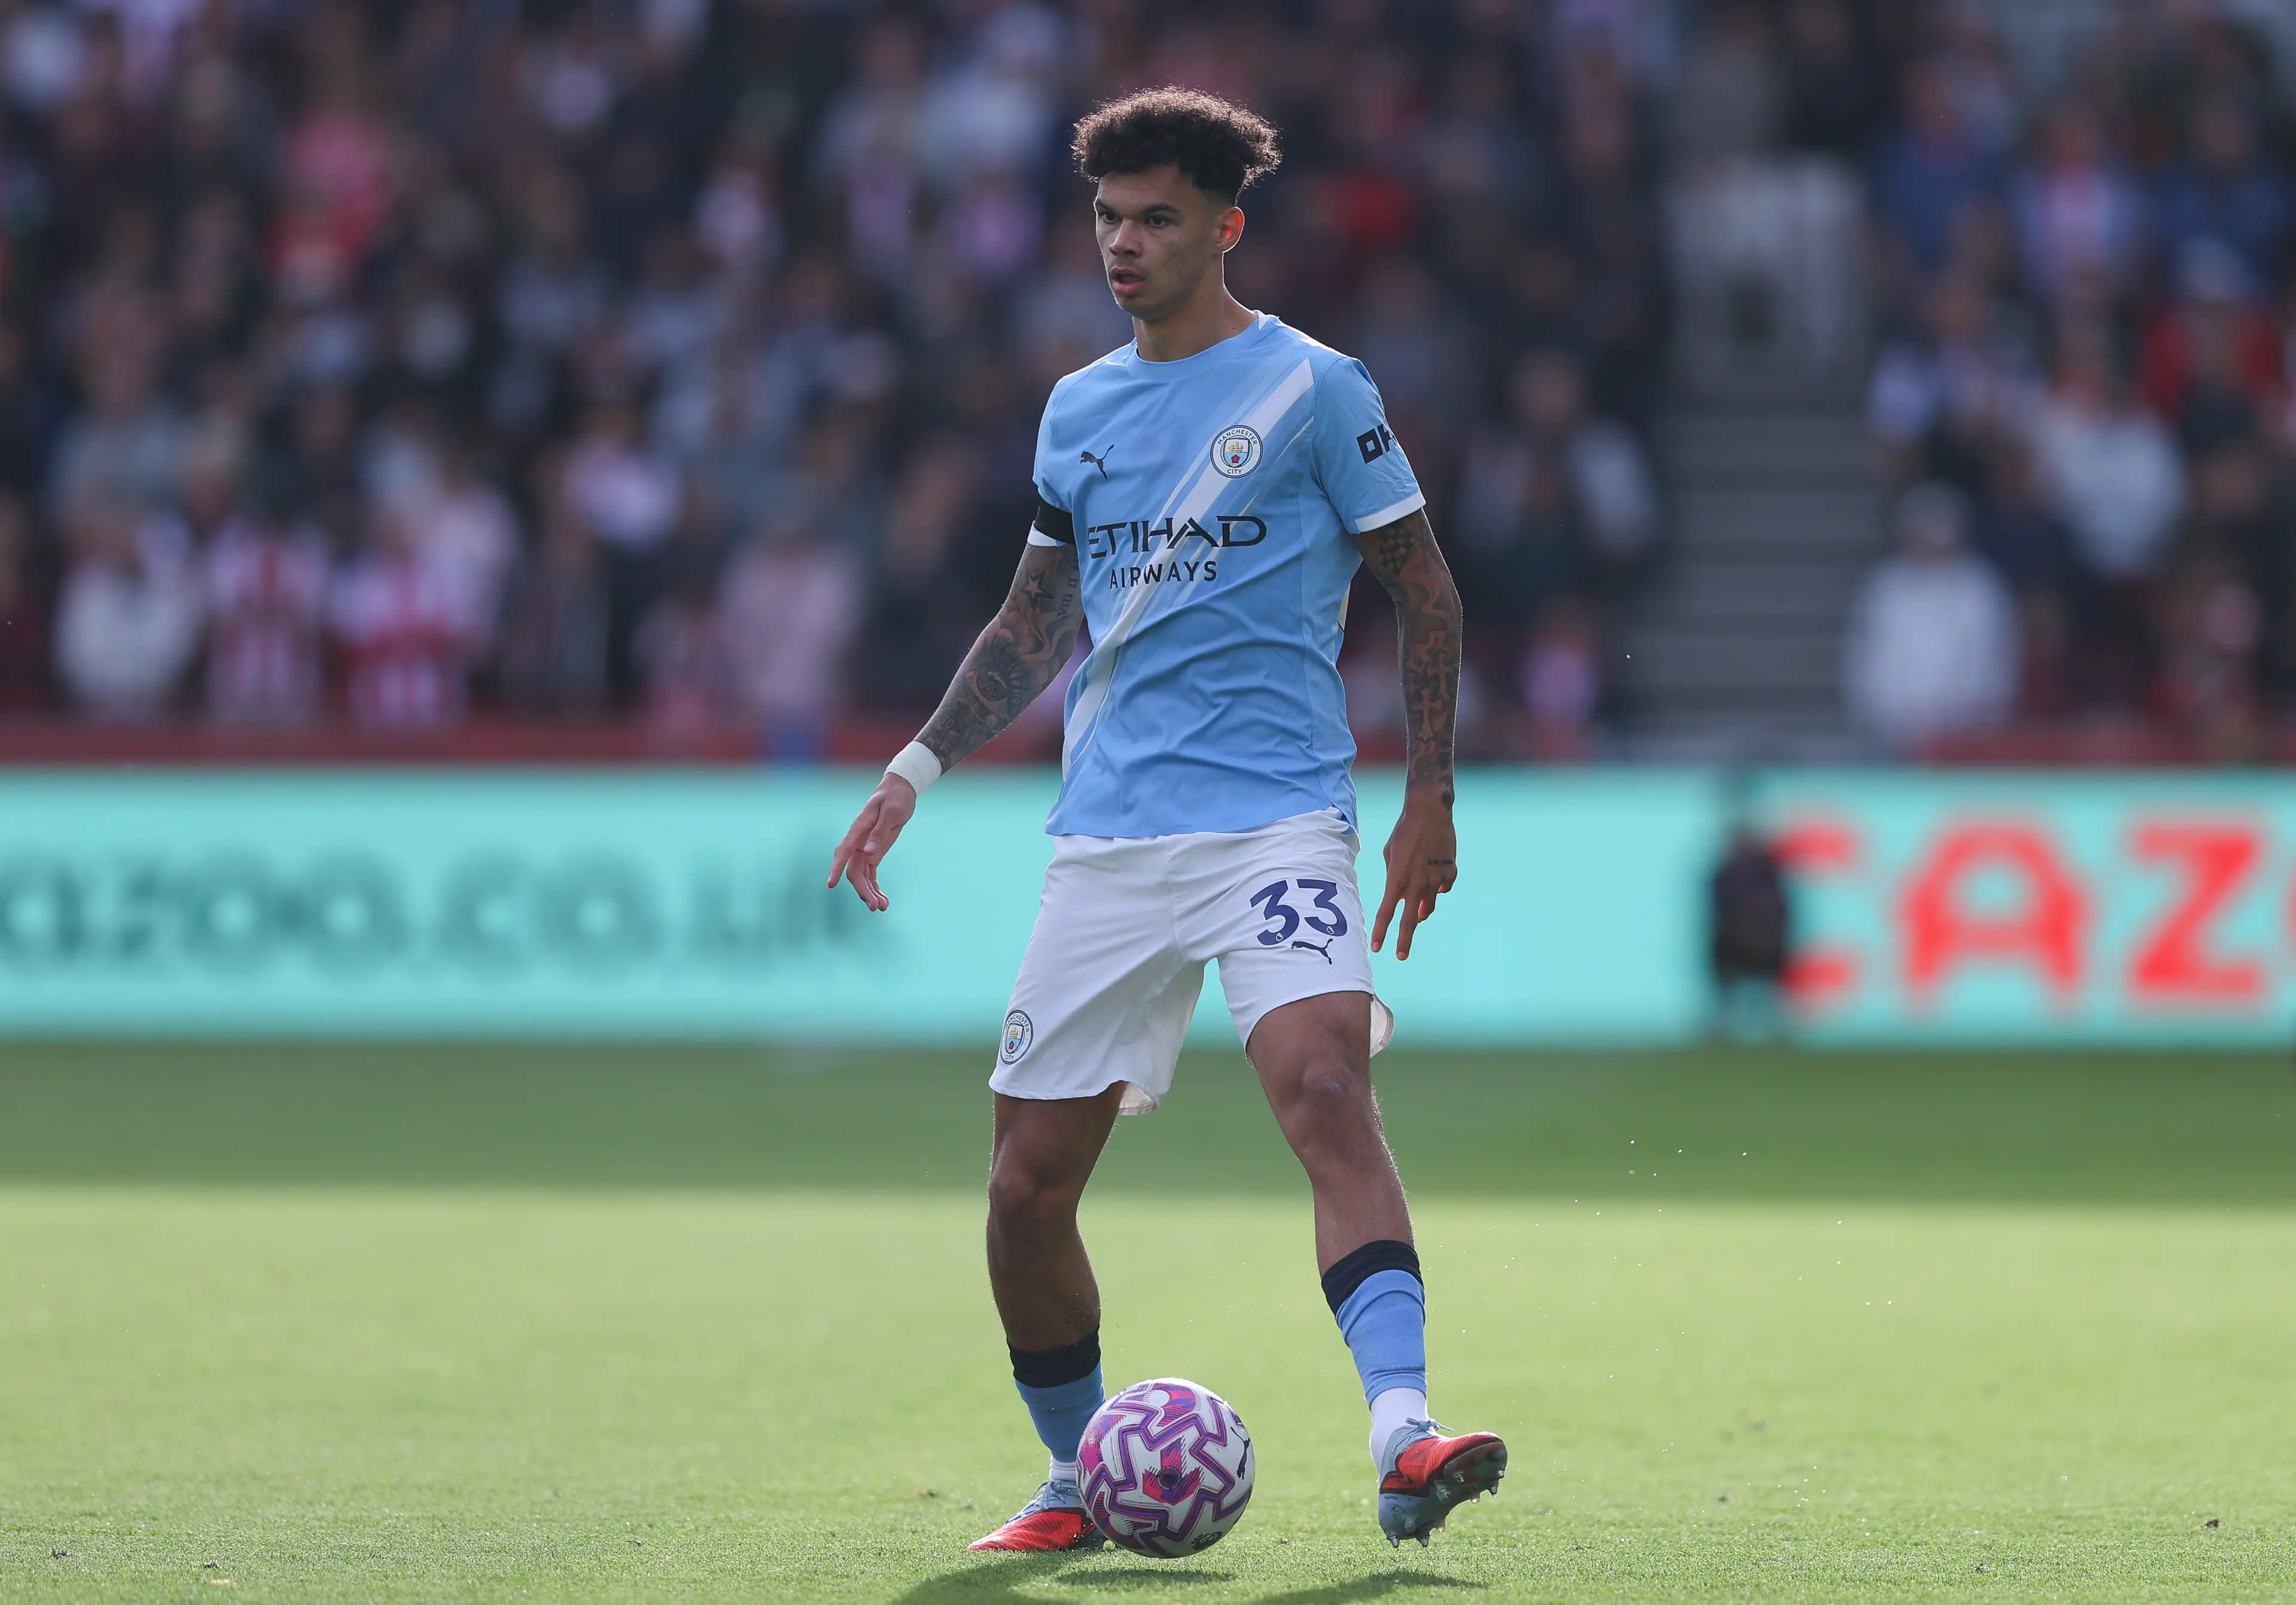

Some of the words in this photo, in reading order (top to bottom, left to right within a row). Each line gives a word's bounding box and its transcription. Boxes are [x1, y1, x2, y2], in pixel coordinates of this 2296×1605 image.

[1217, 429, 1258, 446] MANCHESTER
[1087, 515, 1267, 559] ETIHAD
[1109, 561, 1217, 590] AIRWAYS
[1250, 878, 1348, 946] 33
